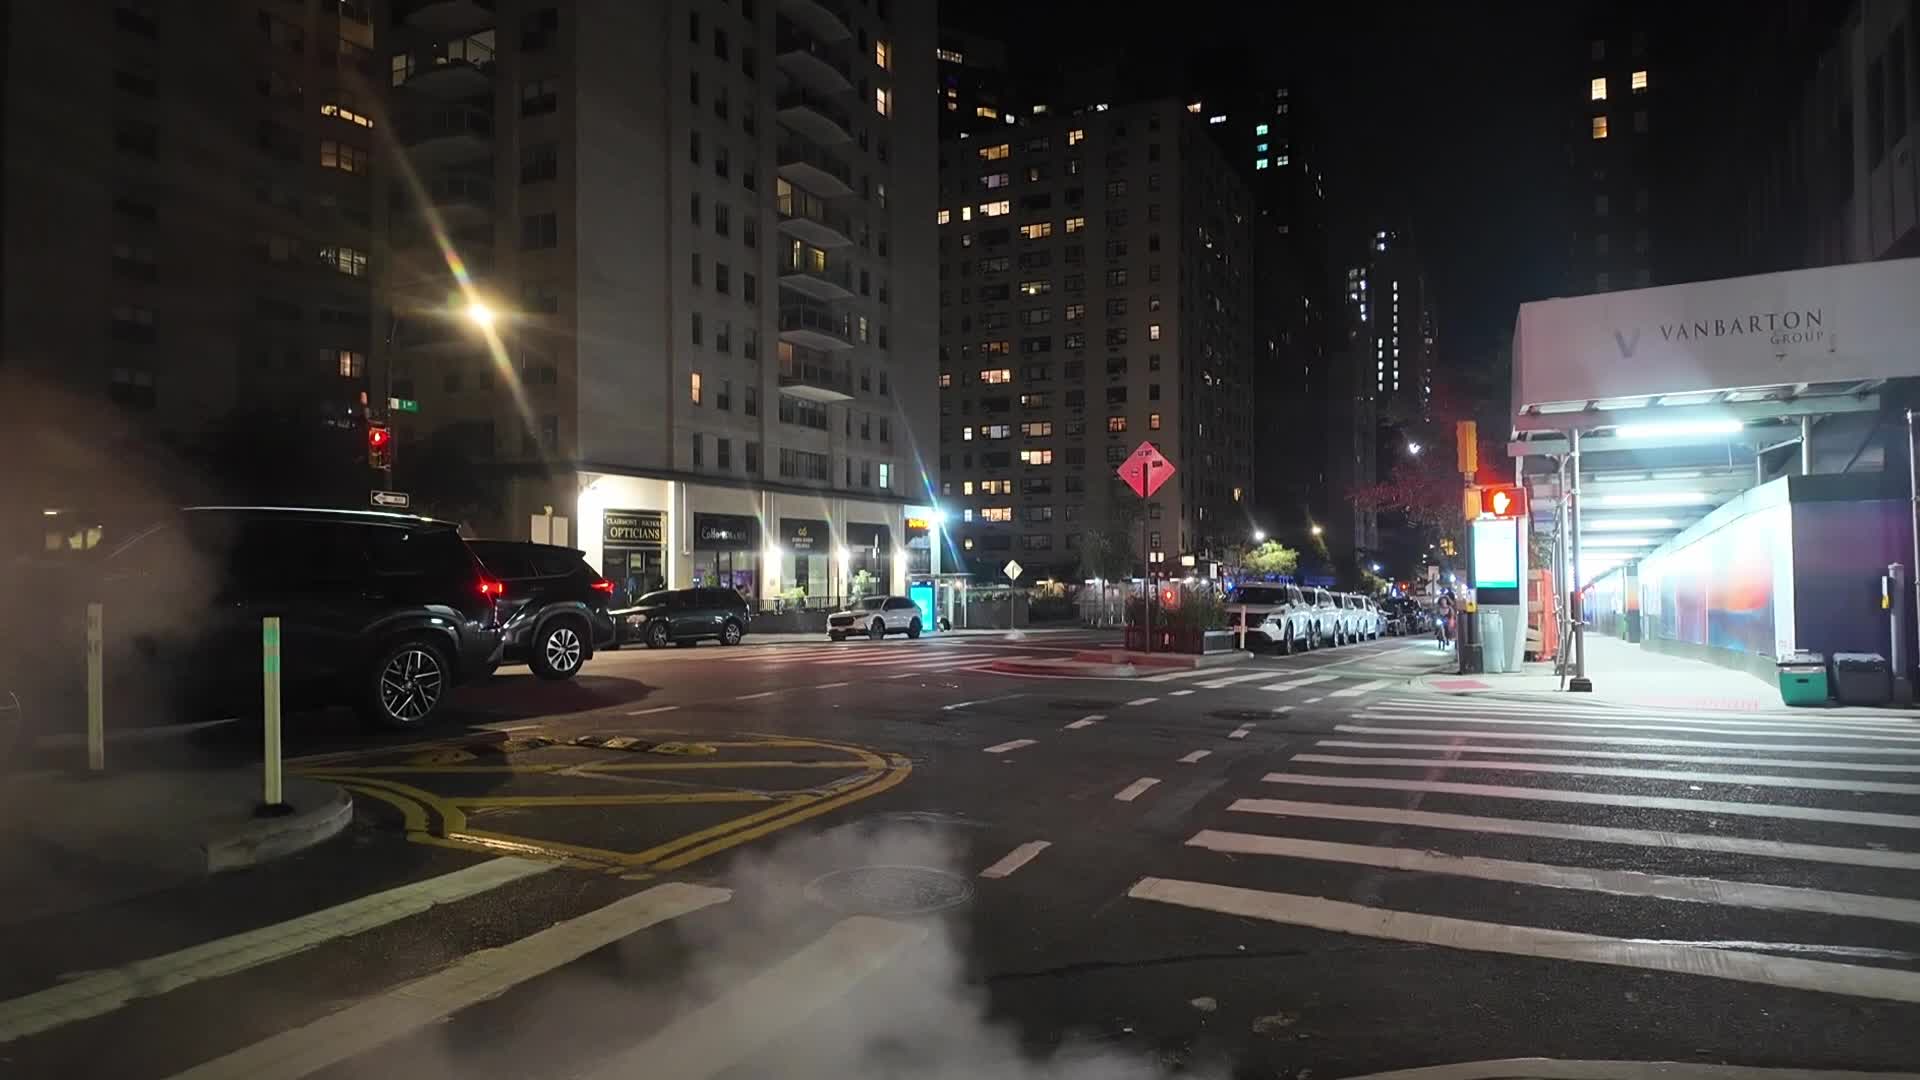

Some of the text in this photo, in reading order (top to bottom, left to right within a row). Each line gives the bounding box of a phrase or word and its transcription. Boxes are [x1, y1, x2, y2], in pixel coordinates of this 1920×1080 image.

[1659, 308, 1823, 342] VANBARTON
[1770, 332, 1824, 345] GROUP
[610, 527, 660, 539] OPTICIANS
